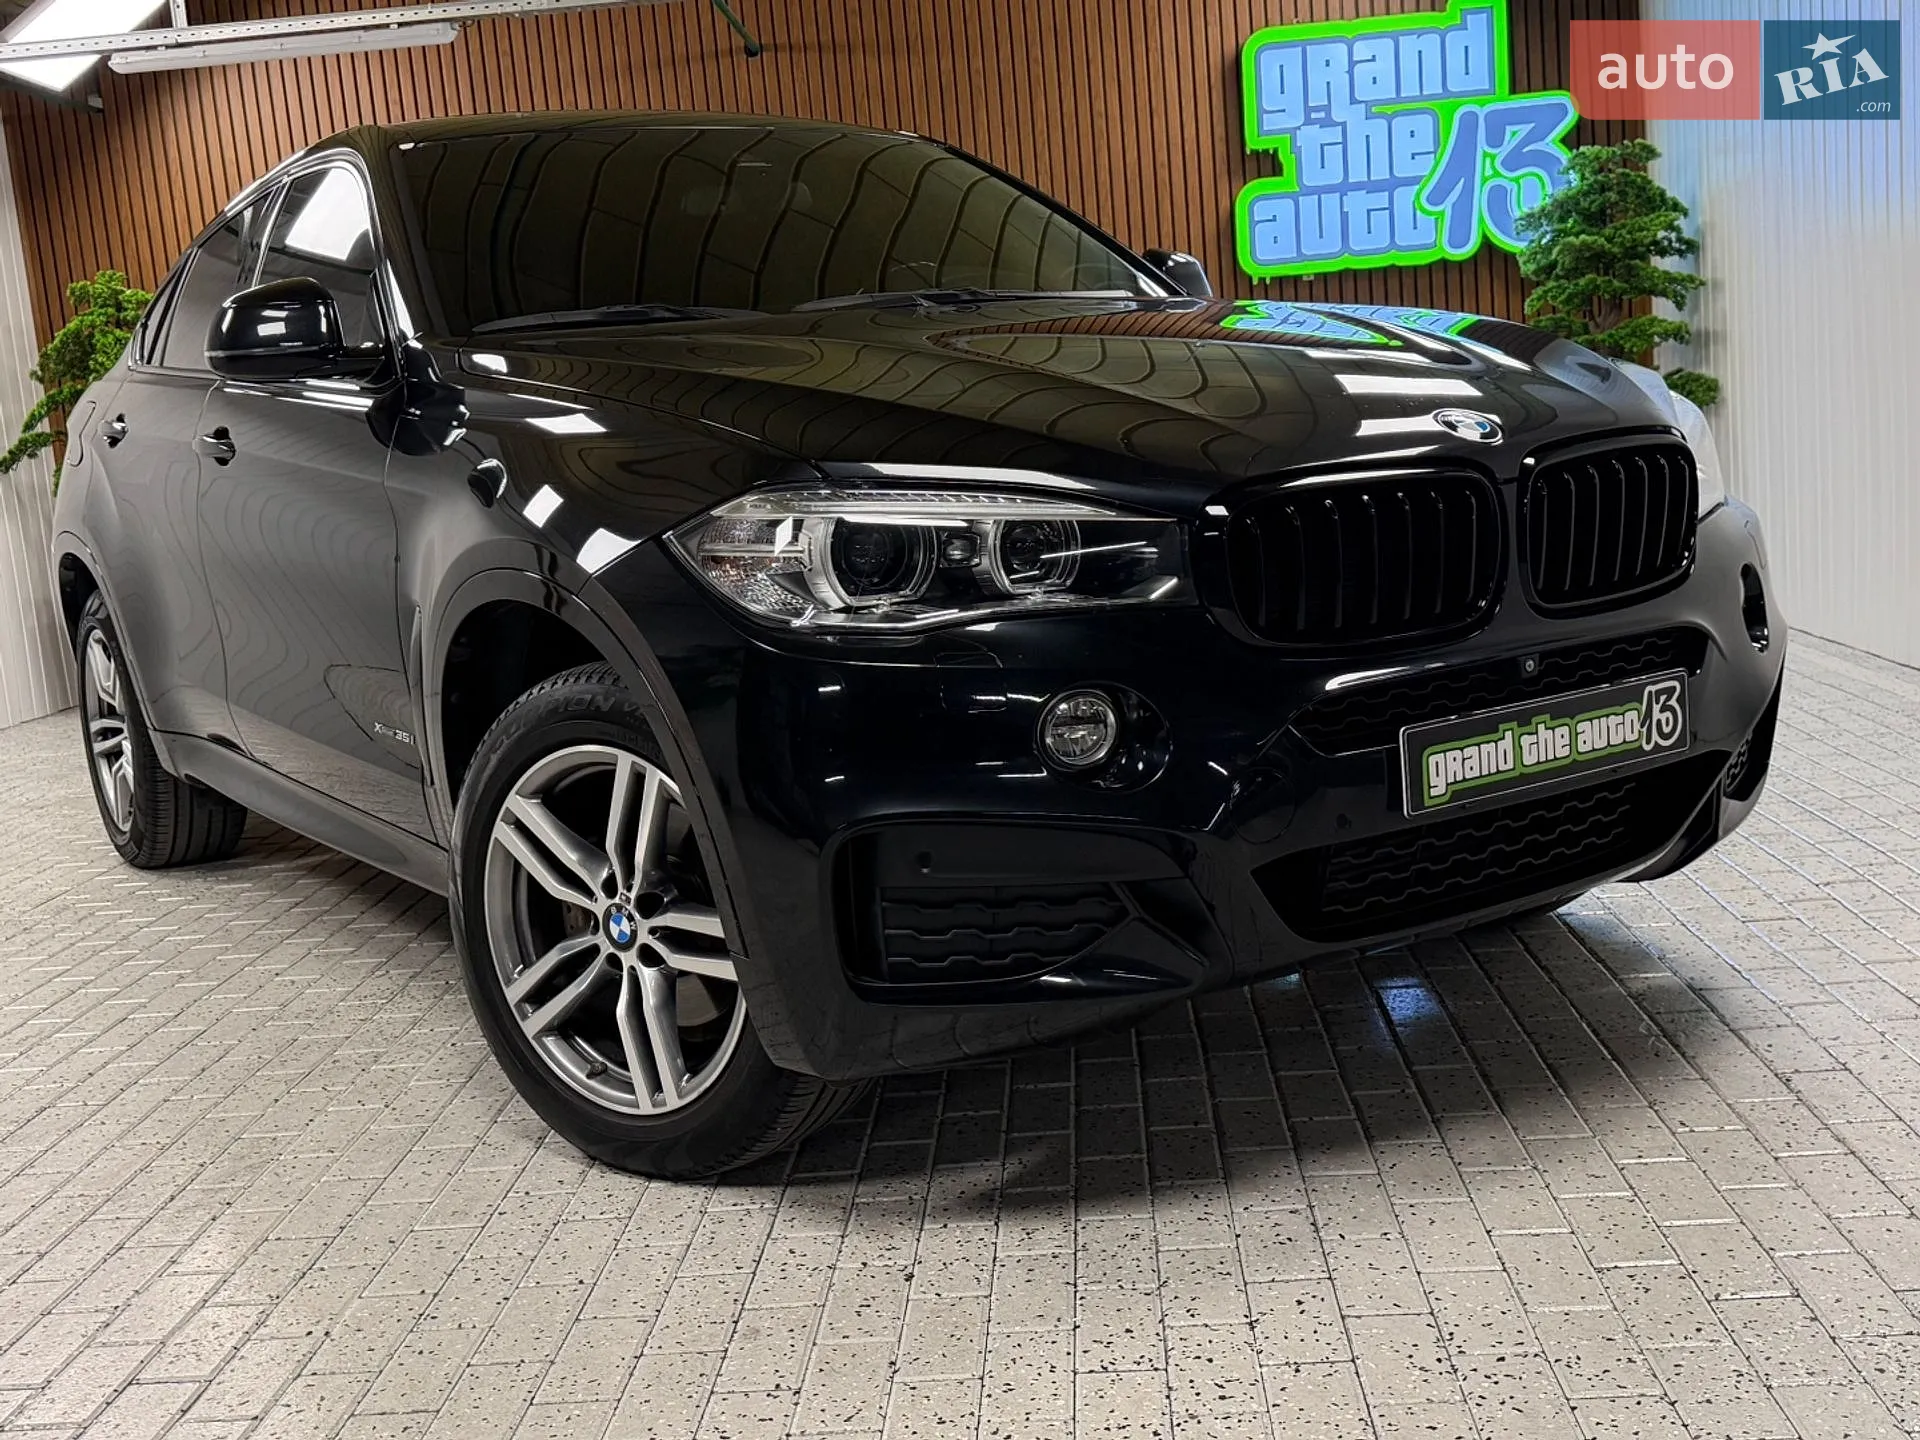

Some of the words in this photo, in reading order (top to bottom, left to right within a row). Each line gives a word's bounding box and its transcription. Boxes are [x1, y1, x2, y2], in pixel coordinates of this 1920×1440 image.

[1296, 102, 1435, 187] the
[1422, 96, 1575, 255] 13
[1519, 723, 1571, 766] the
[1576, 709, 1640, 753] auto
[1638, 680, 1682, 751] 13
